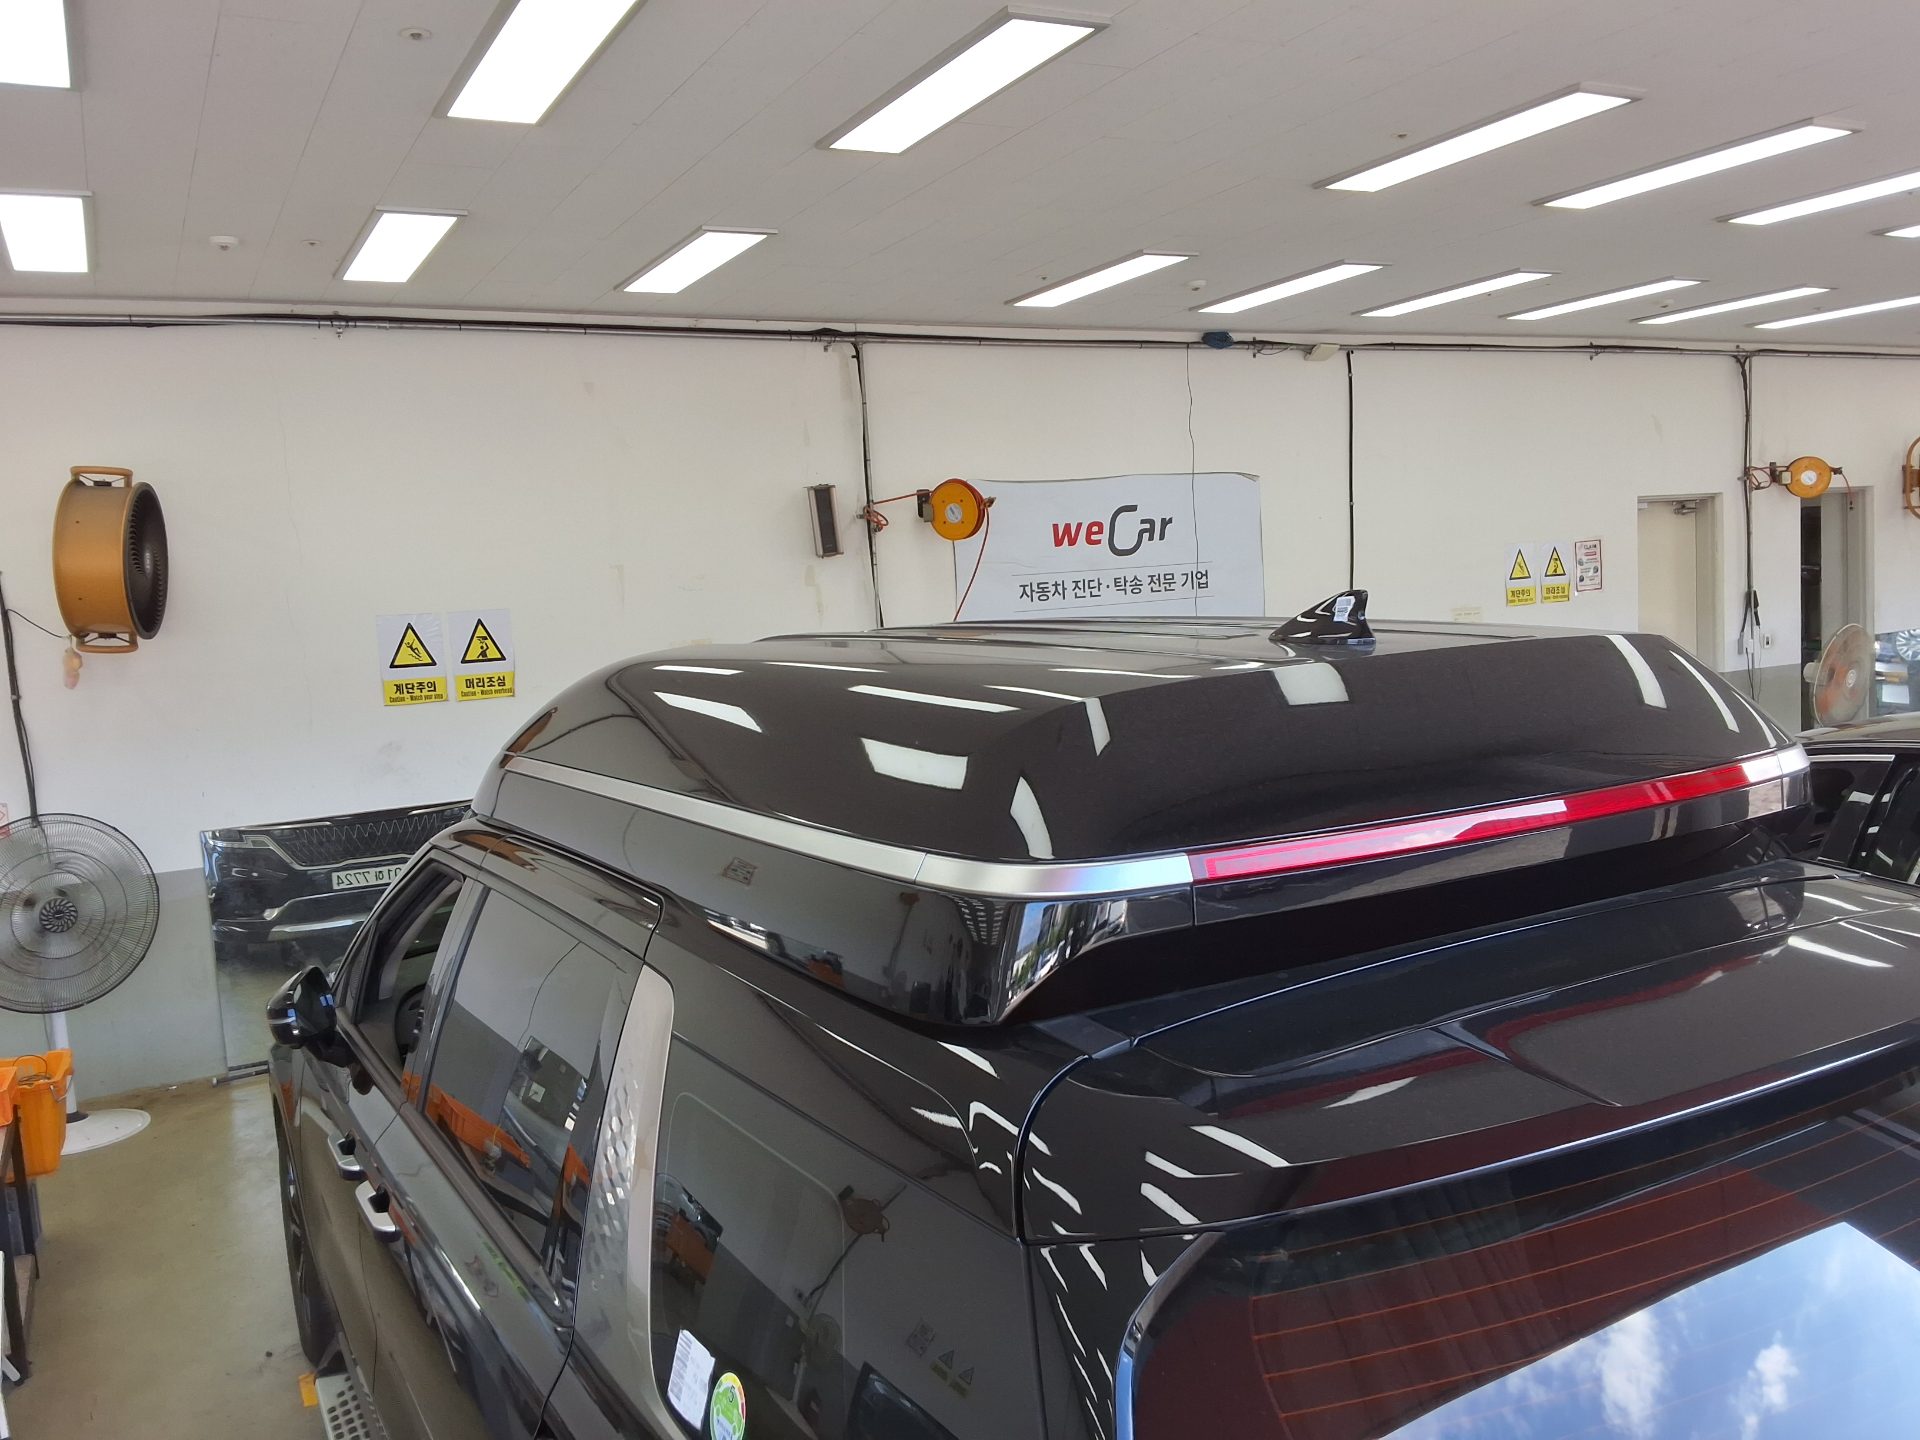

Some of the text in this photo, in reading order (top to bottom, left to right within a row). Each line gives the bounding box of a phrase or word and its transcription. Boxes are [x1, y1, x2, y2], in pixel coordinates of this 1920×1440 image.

[1052, 504, 1173, 556] weCar
[1018, 580, 1067, 603] 자동차
[1147, 571, 1177, 593] 전문
[1181, 569, 1210, 590] 기업
[394, 681, 437, 695] 계단주의
[465, 676, 506, 690] 머리조심
